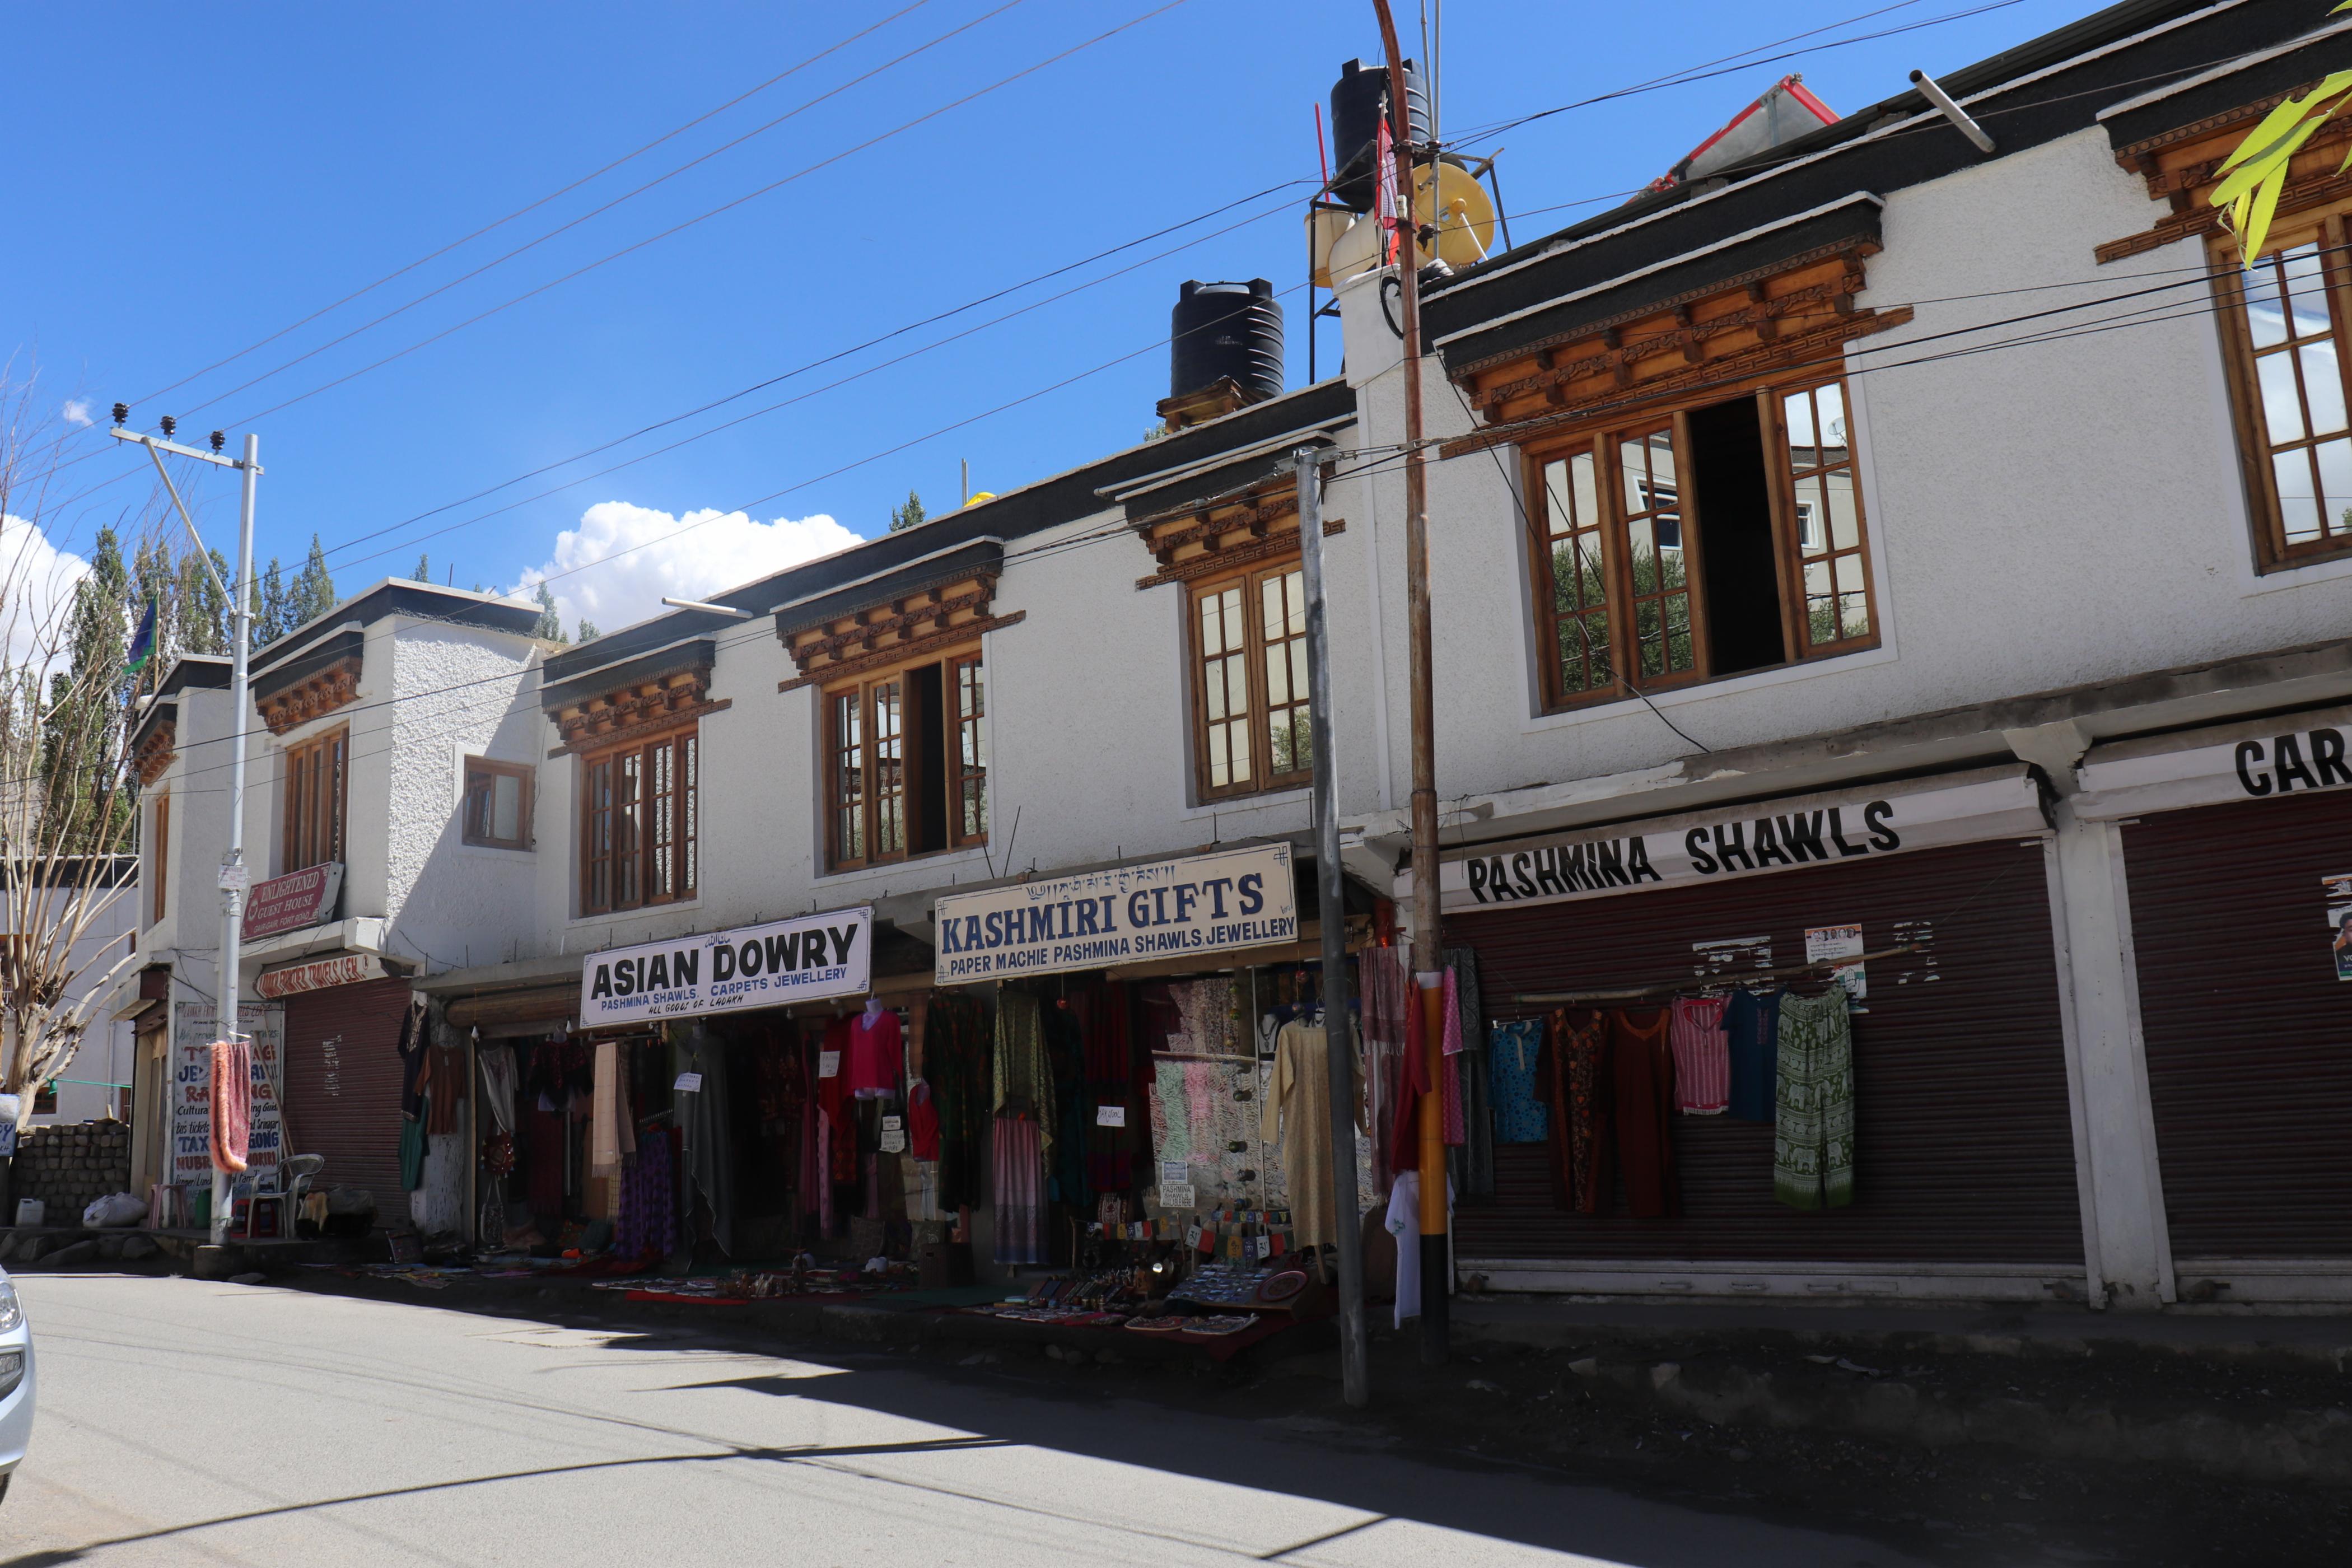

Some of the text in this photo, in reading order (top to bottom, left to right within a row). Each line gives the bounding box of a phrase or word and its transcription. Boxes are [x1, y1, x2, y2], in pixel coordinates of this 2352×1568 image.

[2235, 728, 2352, 796] CAR
[1467, 800, 1900, 903] PASHMINA SHAWLS
[260, 871, 319, 903] ENLIGHTENED
[258, 894, 314, 919] GUEST HOUSE
[280, 916, 295, 926] FORT
[295, 911, 310, 922] ROAD
[941, 872, 1264, 954] KASHMIRI GIFTS
[950, 955, 991, 976] PAPER
[995, 948, 1047, 971] MACHIE
[1053, 939, 1131, 963] PASHMINA
[1206, 916, 1295, 945] JEWELLERY
[307, 960, 342, 988] TRAVELS
[590, 923, 858, 1000] ASIAN DOWRY
[601, 995, 650, 1011] PASHMINA
[711, 978, 768, 997] CARPETS
[774, 967, 847, 988] JEWELLERY
[648, 1004, 661, 1015] ALL
[693, 998, 704, 1008] OF
[710, 993, 744, 1007] LADAKH
[177, 1105, 209, 1116] Cultura
[263, 1102, 278, 1112] Guid
[189, 1121, 210, 1133] tickets
[258, 1118, 279, 1133] Srinagar
[178, 1132, 279, 1152] TAX GONG
[176, 1156, 213, 1171] NUBR
